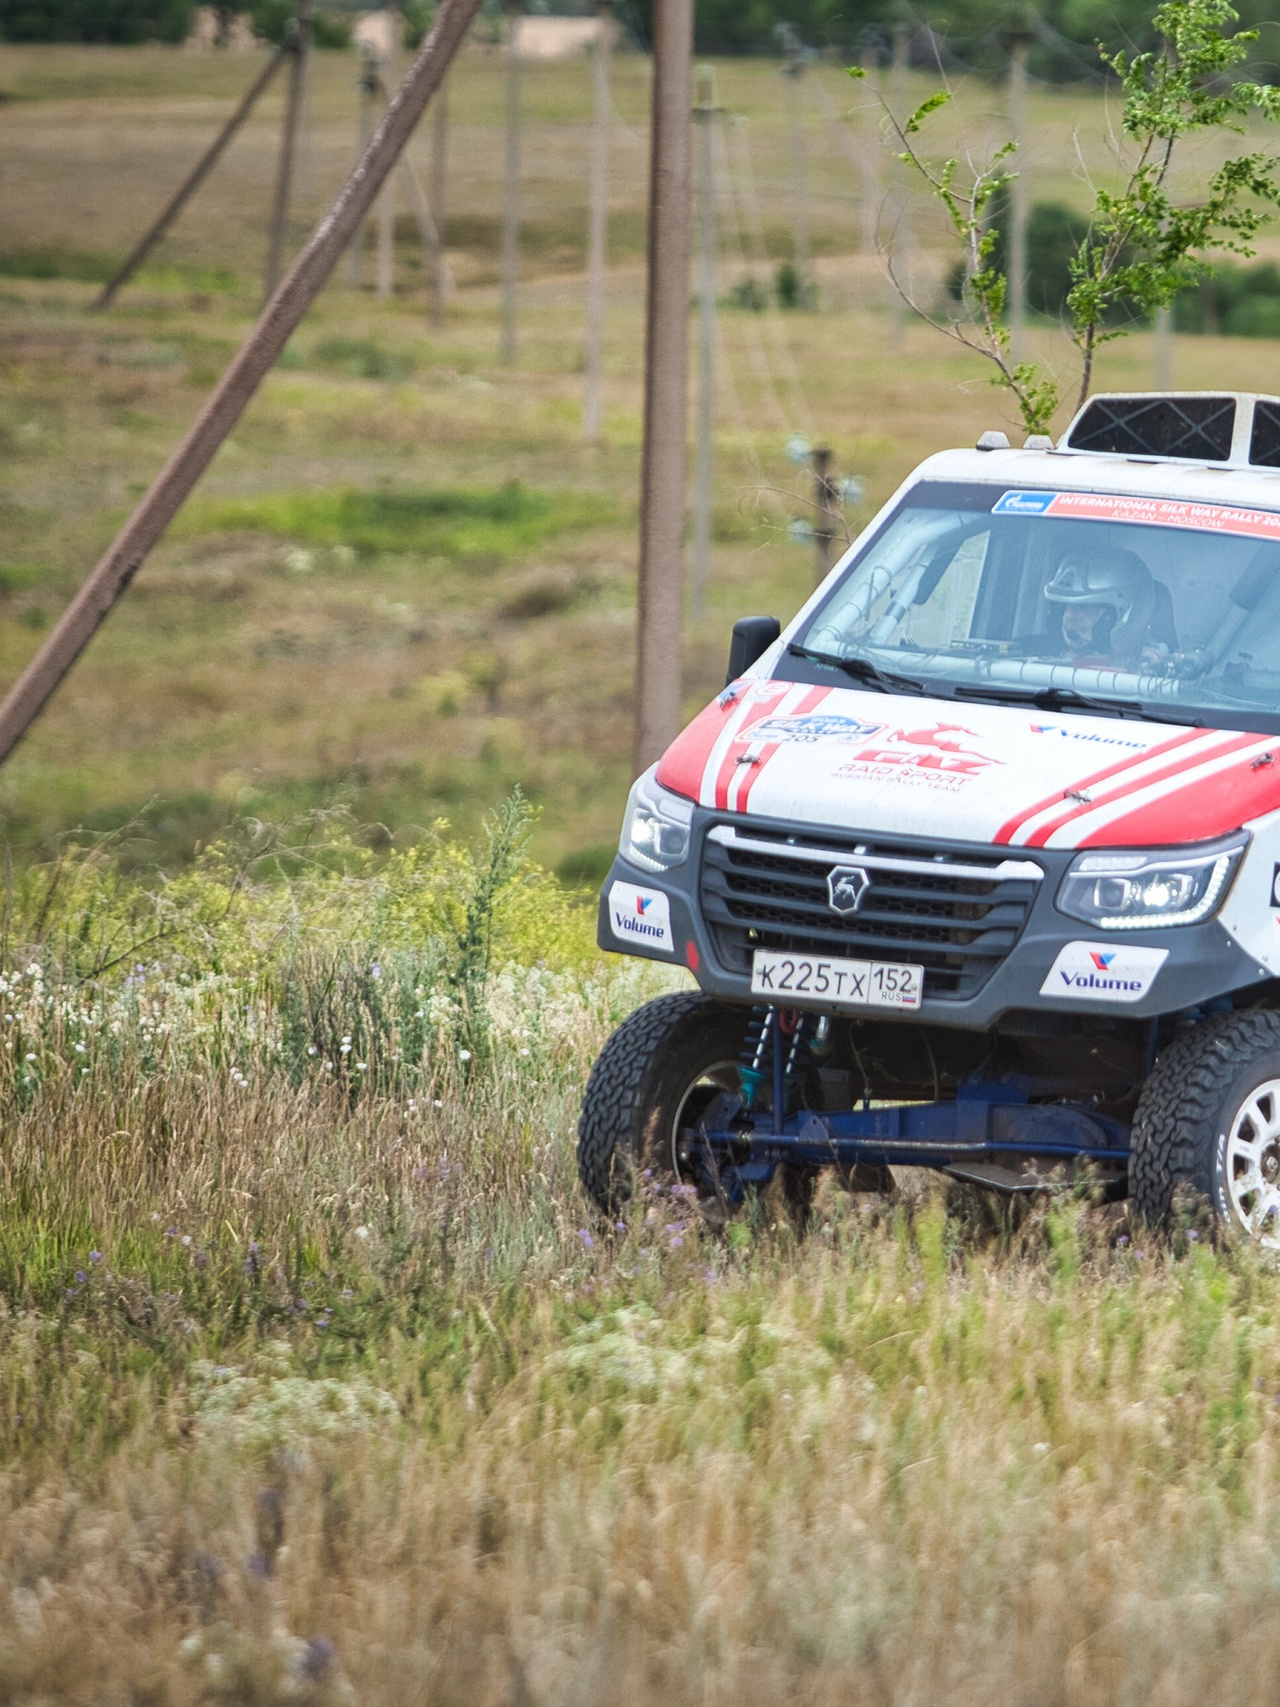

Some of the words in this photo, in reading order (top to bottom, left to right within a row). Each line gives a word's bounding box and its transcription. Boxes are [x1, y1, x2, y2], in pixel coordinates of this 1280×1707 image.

[1059, 496, 1157, 511] INTERNATIONAL
[1159, 503, 1188, 515] SILK
[1190, 506, 1221, 517] WAY
[1220, 509, 1263, 523] RALLY
[1112, 510, 1156, 520] KAZAN
[1167, 515, 1225, 528] MOSCOW
[782, 734, 821, 742] 205
[1060, 728, 1147, 750] Volume
[853, 749, 992, 776] GAZ
[830, 772, 882, 782] RUSSIAN
[928, 783, 961, 793] TEAM
[837, 763, 894, 775] RAID
[900, 767, 973, 785] SPORT
[615, 912, 665, 939] Volume
[873, 966, 914, 993] 152
[1059, 970, 1142, 991] Volume
[880, 991, 901, 1002] RUS
